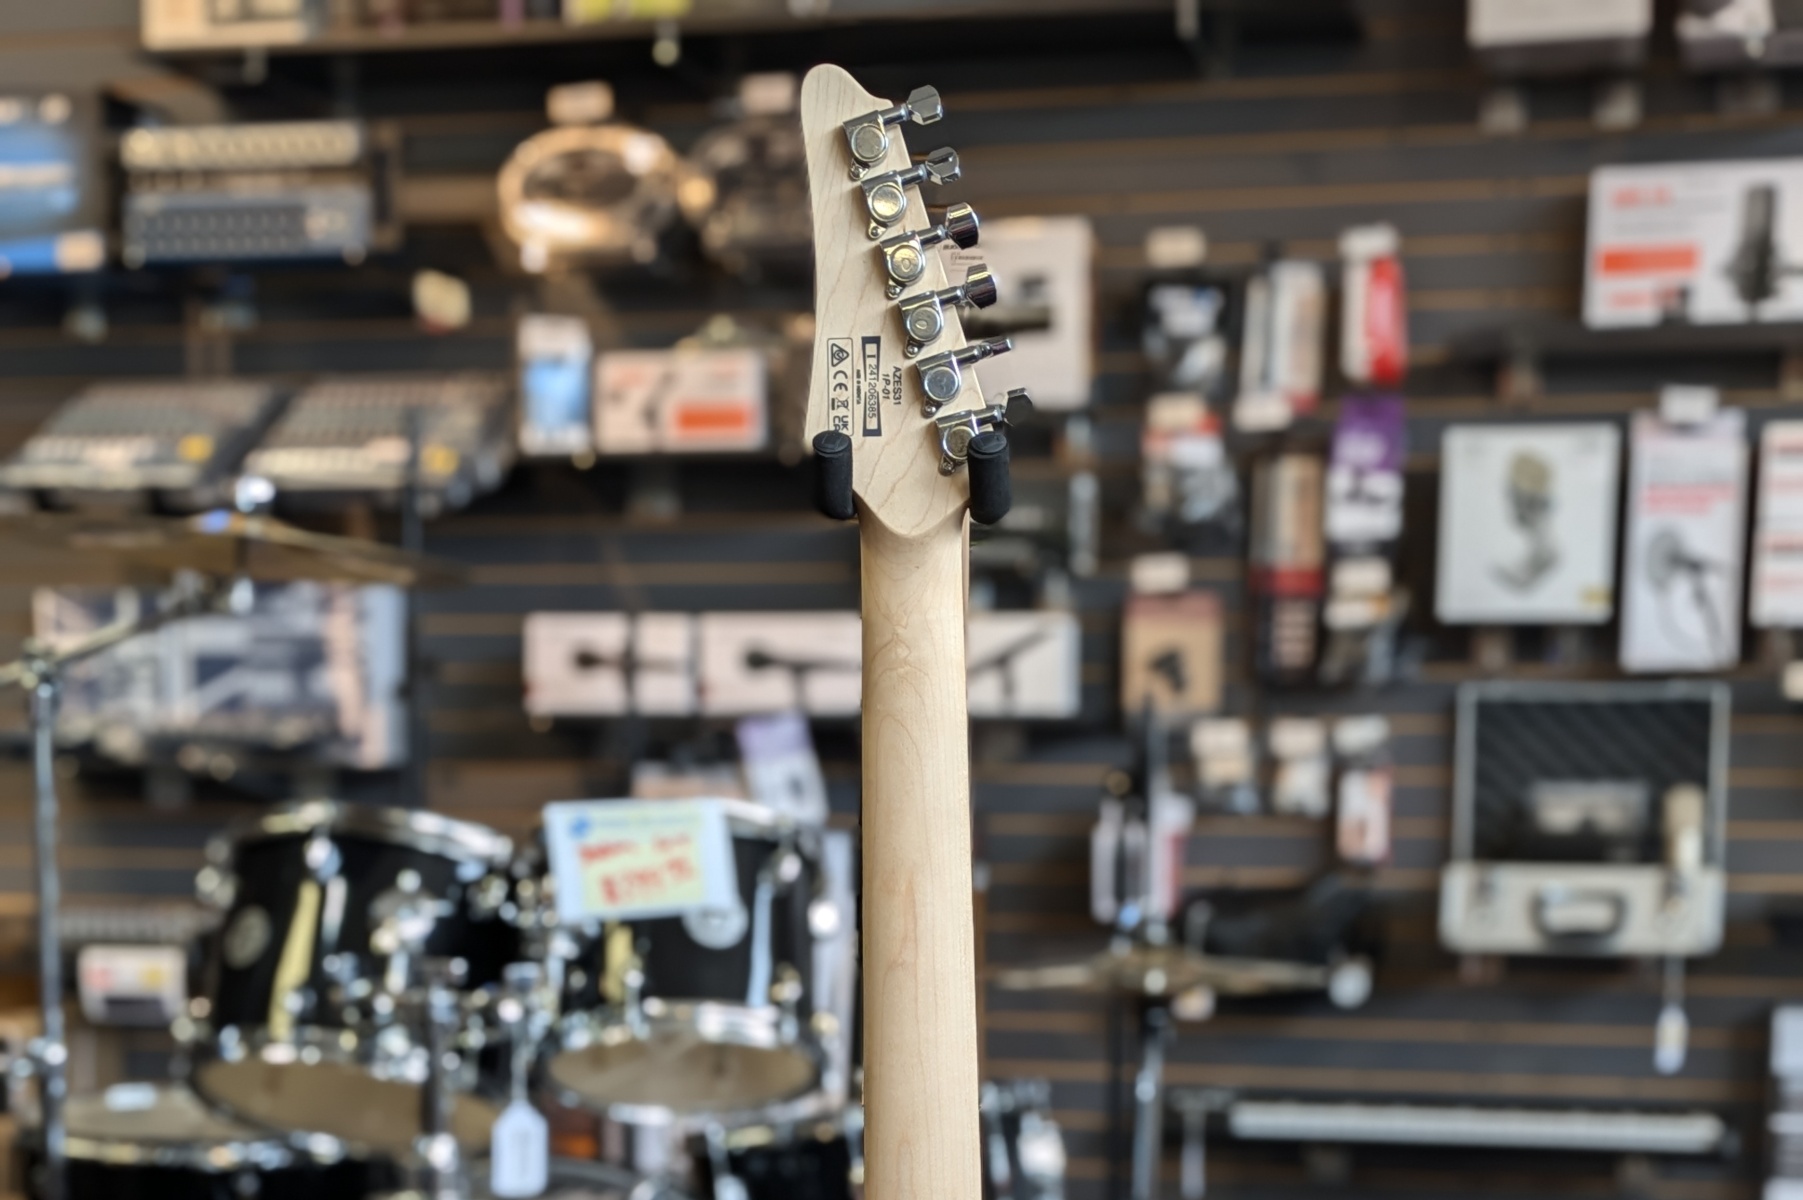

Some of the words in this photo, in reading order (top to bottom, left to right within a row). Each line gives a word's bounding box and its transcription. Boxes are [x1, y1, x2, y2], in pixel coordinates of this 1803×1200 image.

[833, 370, 848, 392] CE
[882, 373, 891, 400] 1P-01
[893, 366, 902, 405] AZES31
[841, 415, 849, 431] UK
